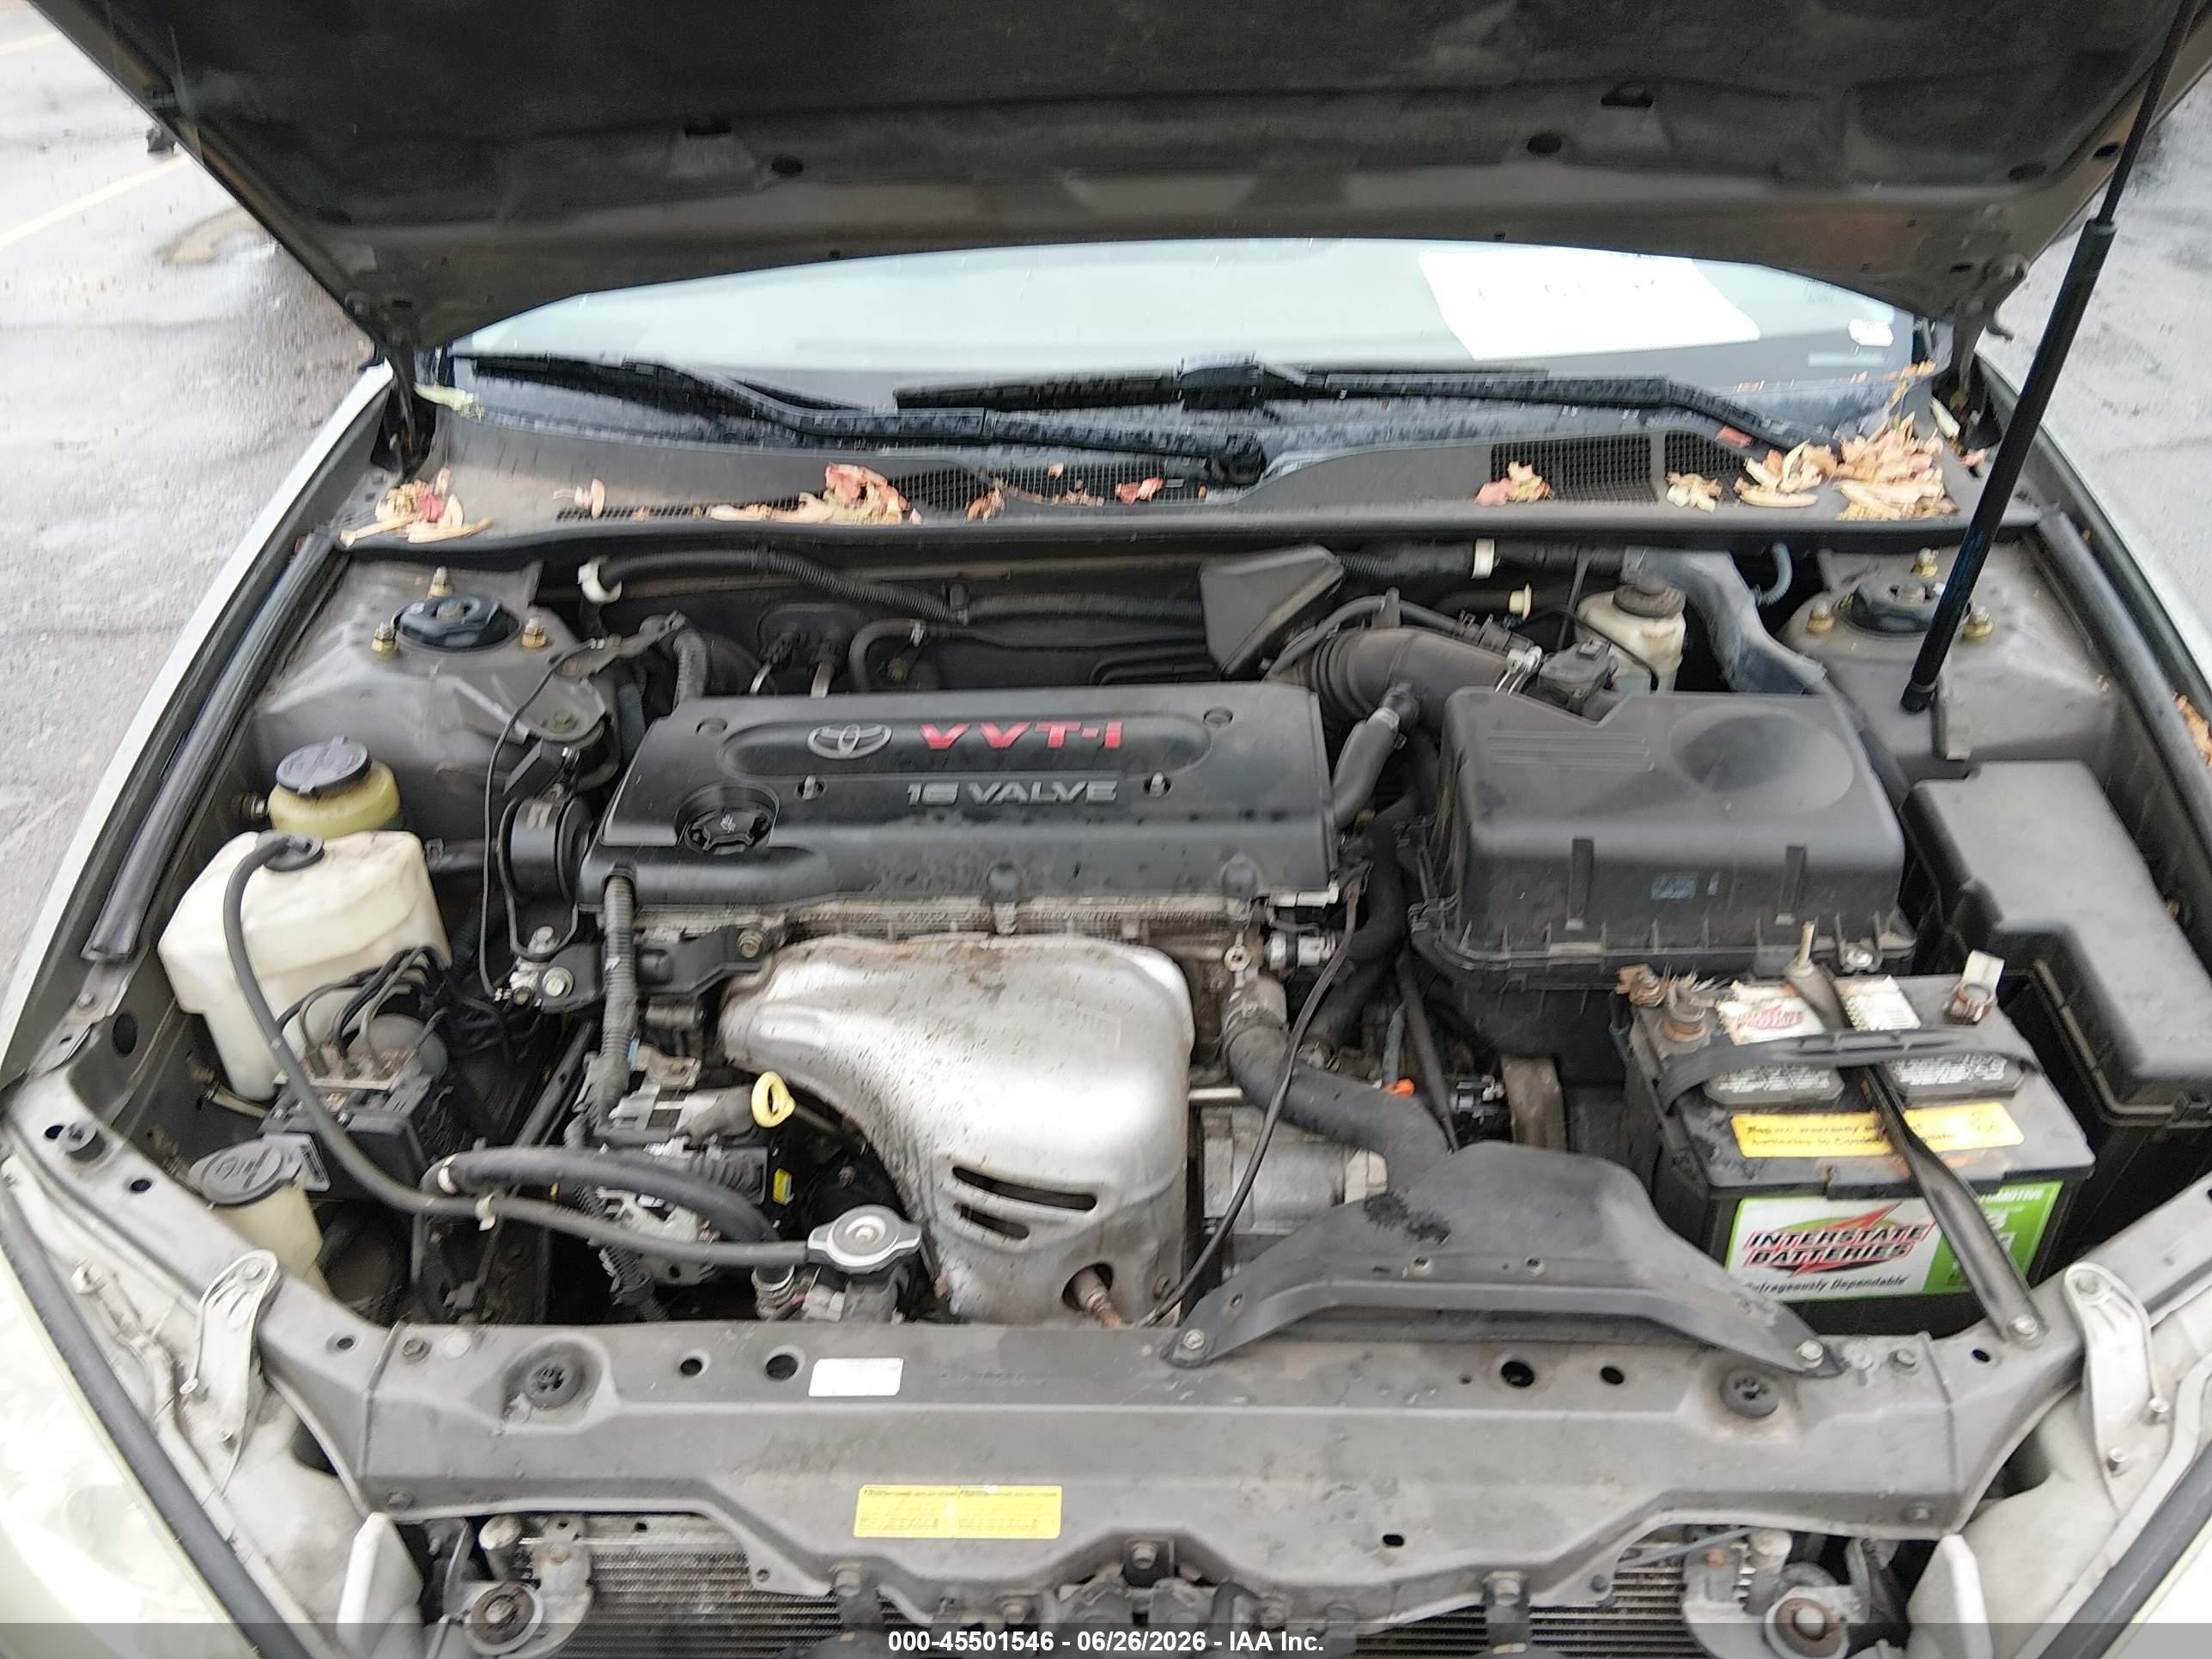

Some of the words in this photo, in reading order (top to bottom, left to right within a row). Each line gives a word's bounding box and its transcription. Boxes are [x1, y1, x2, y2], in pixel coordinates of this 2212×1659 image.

[907, 782, 960, 805] 16
[968, 781, 1119, 805] VALVE
[1748, 1224, 1929, 1249] INTERSTATE
[1748, 1243, 1911, 1267] BATTERIES
[1830, 1274, 1910, 1291] Dependable
